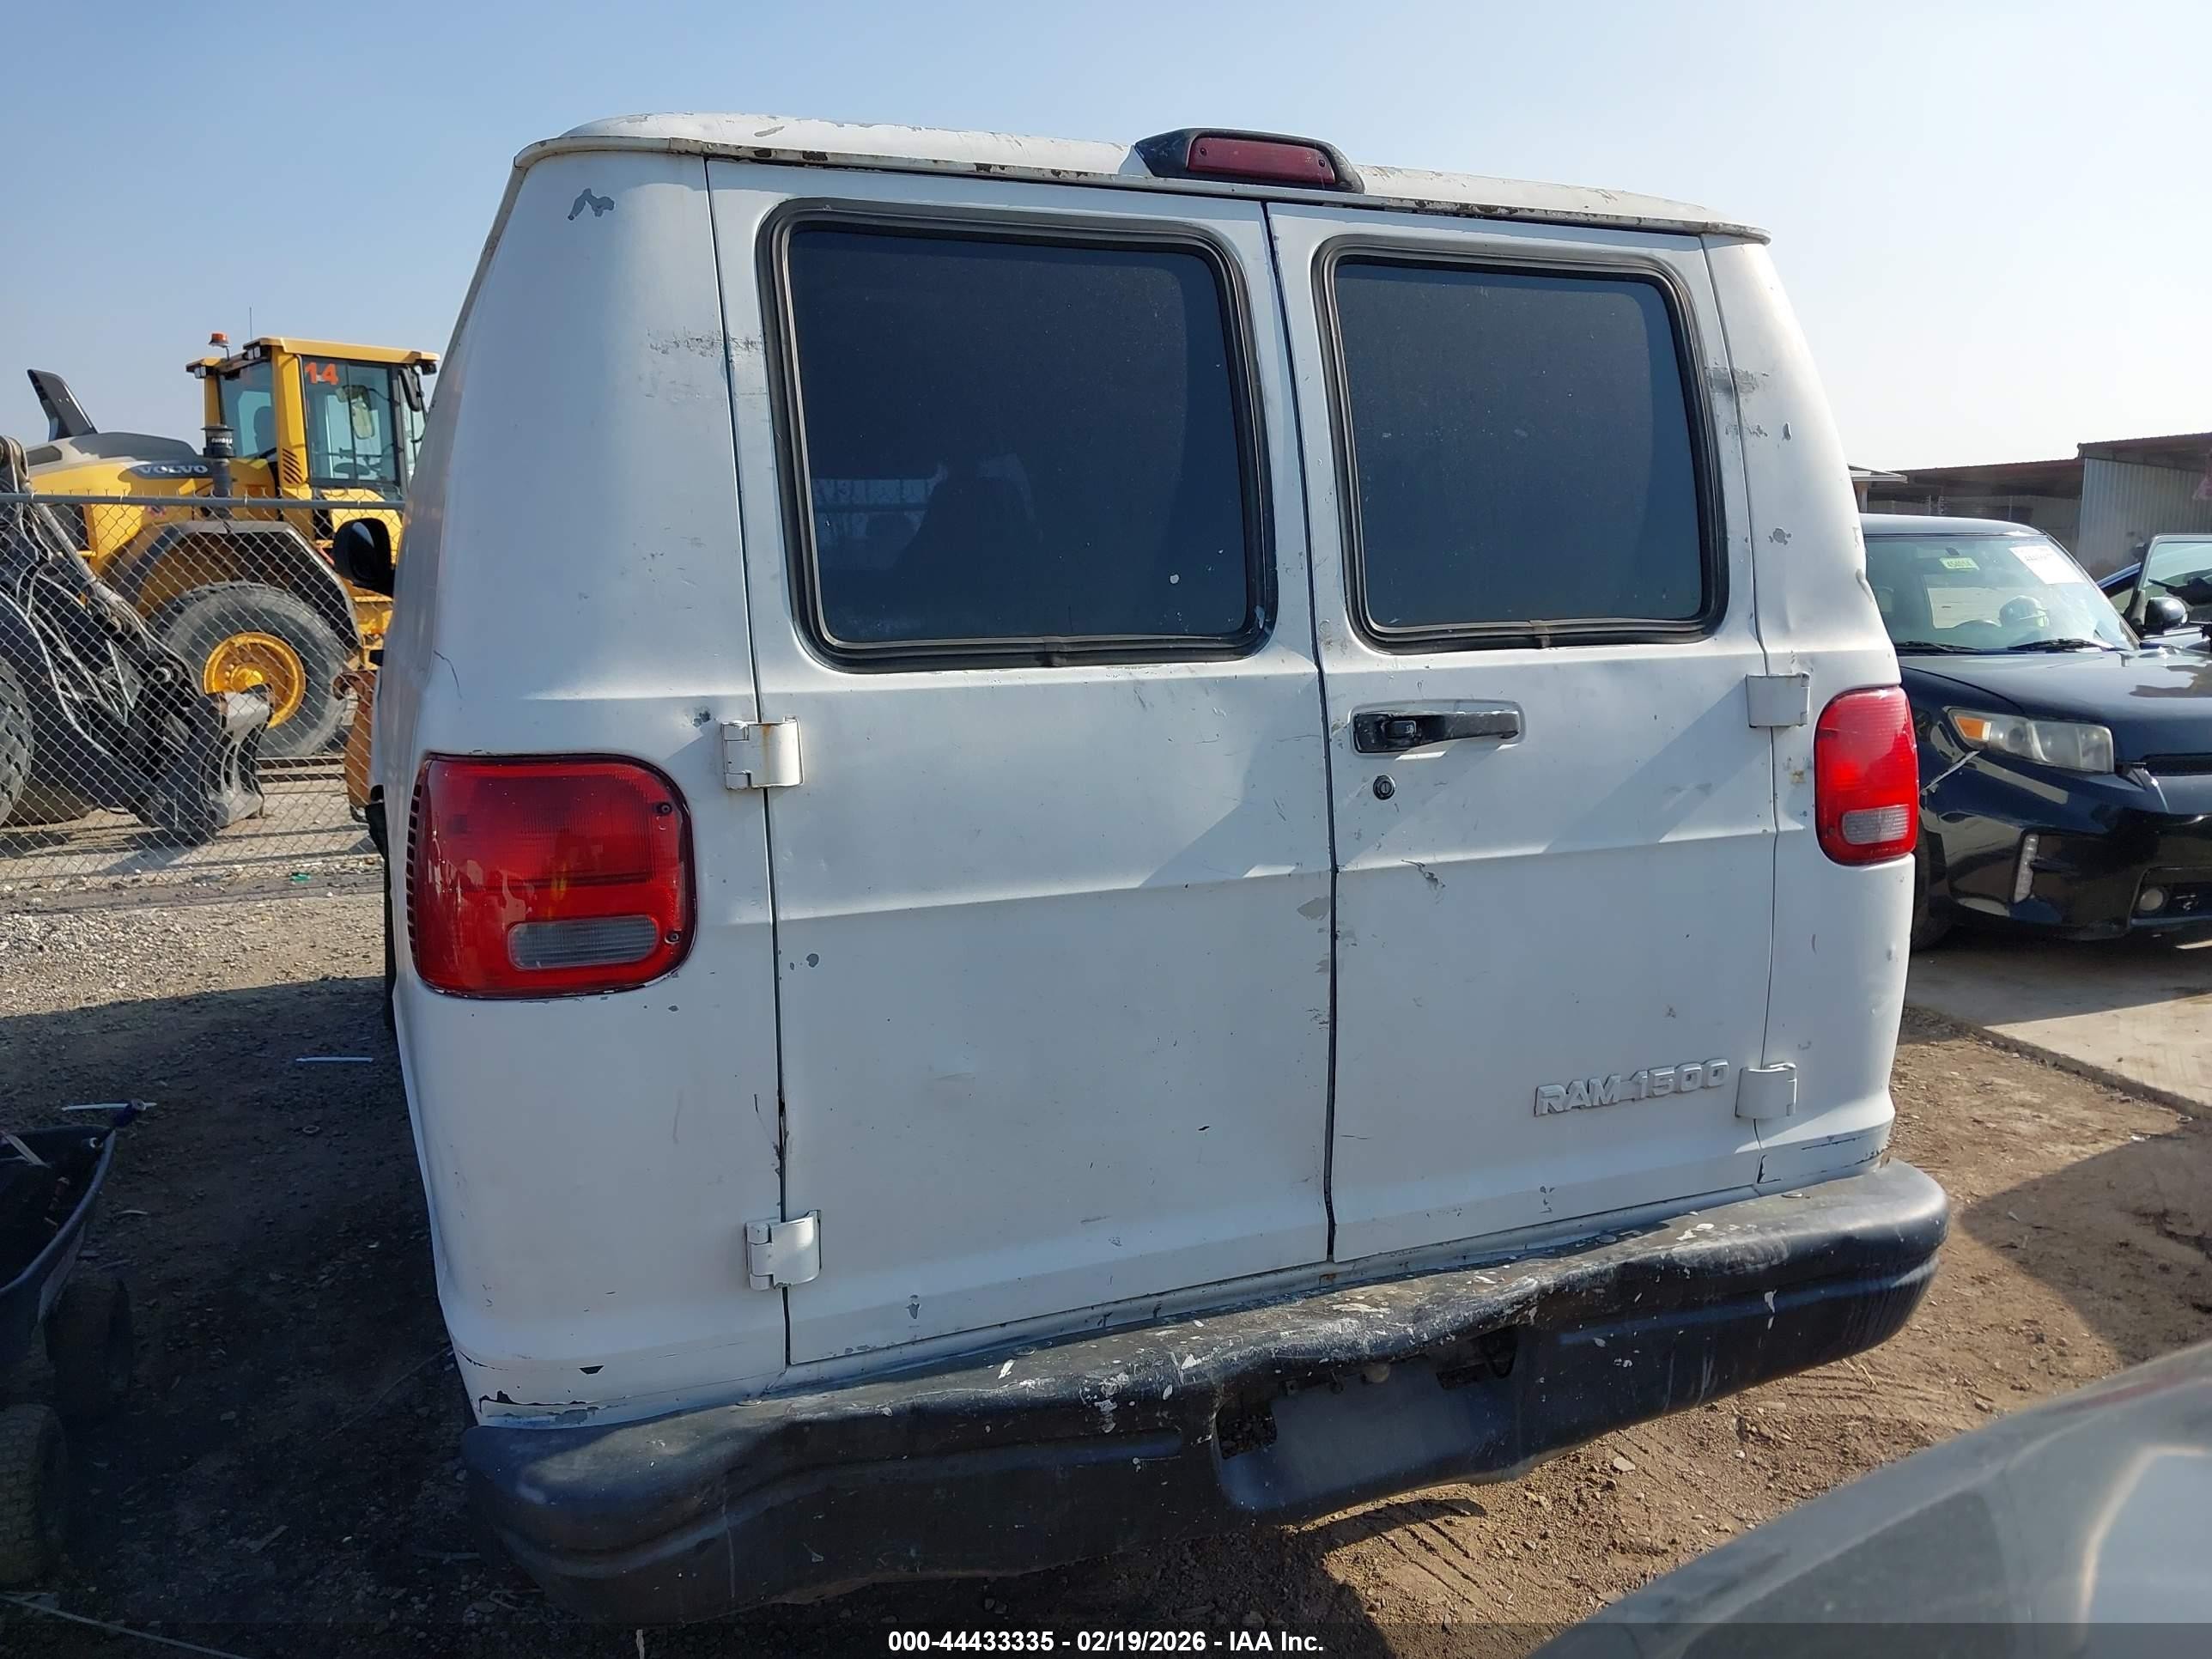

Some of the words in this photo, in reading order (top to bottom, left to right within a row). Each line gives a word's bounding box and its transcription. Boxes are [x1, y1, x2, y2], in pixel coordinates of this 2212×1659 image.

[137, 465, 209, 474] VOLVO
[1534, 1073, 1622, 1116] RAM
[1629, 1057, 1730, 1103] 1500
